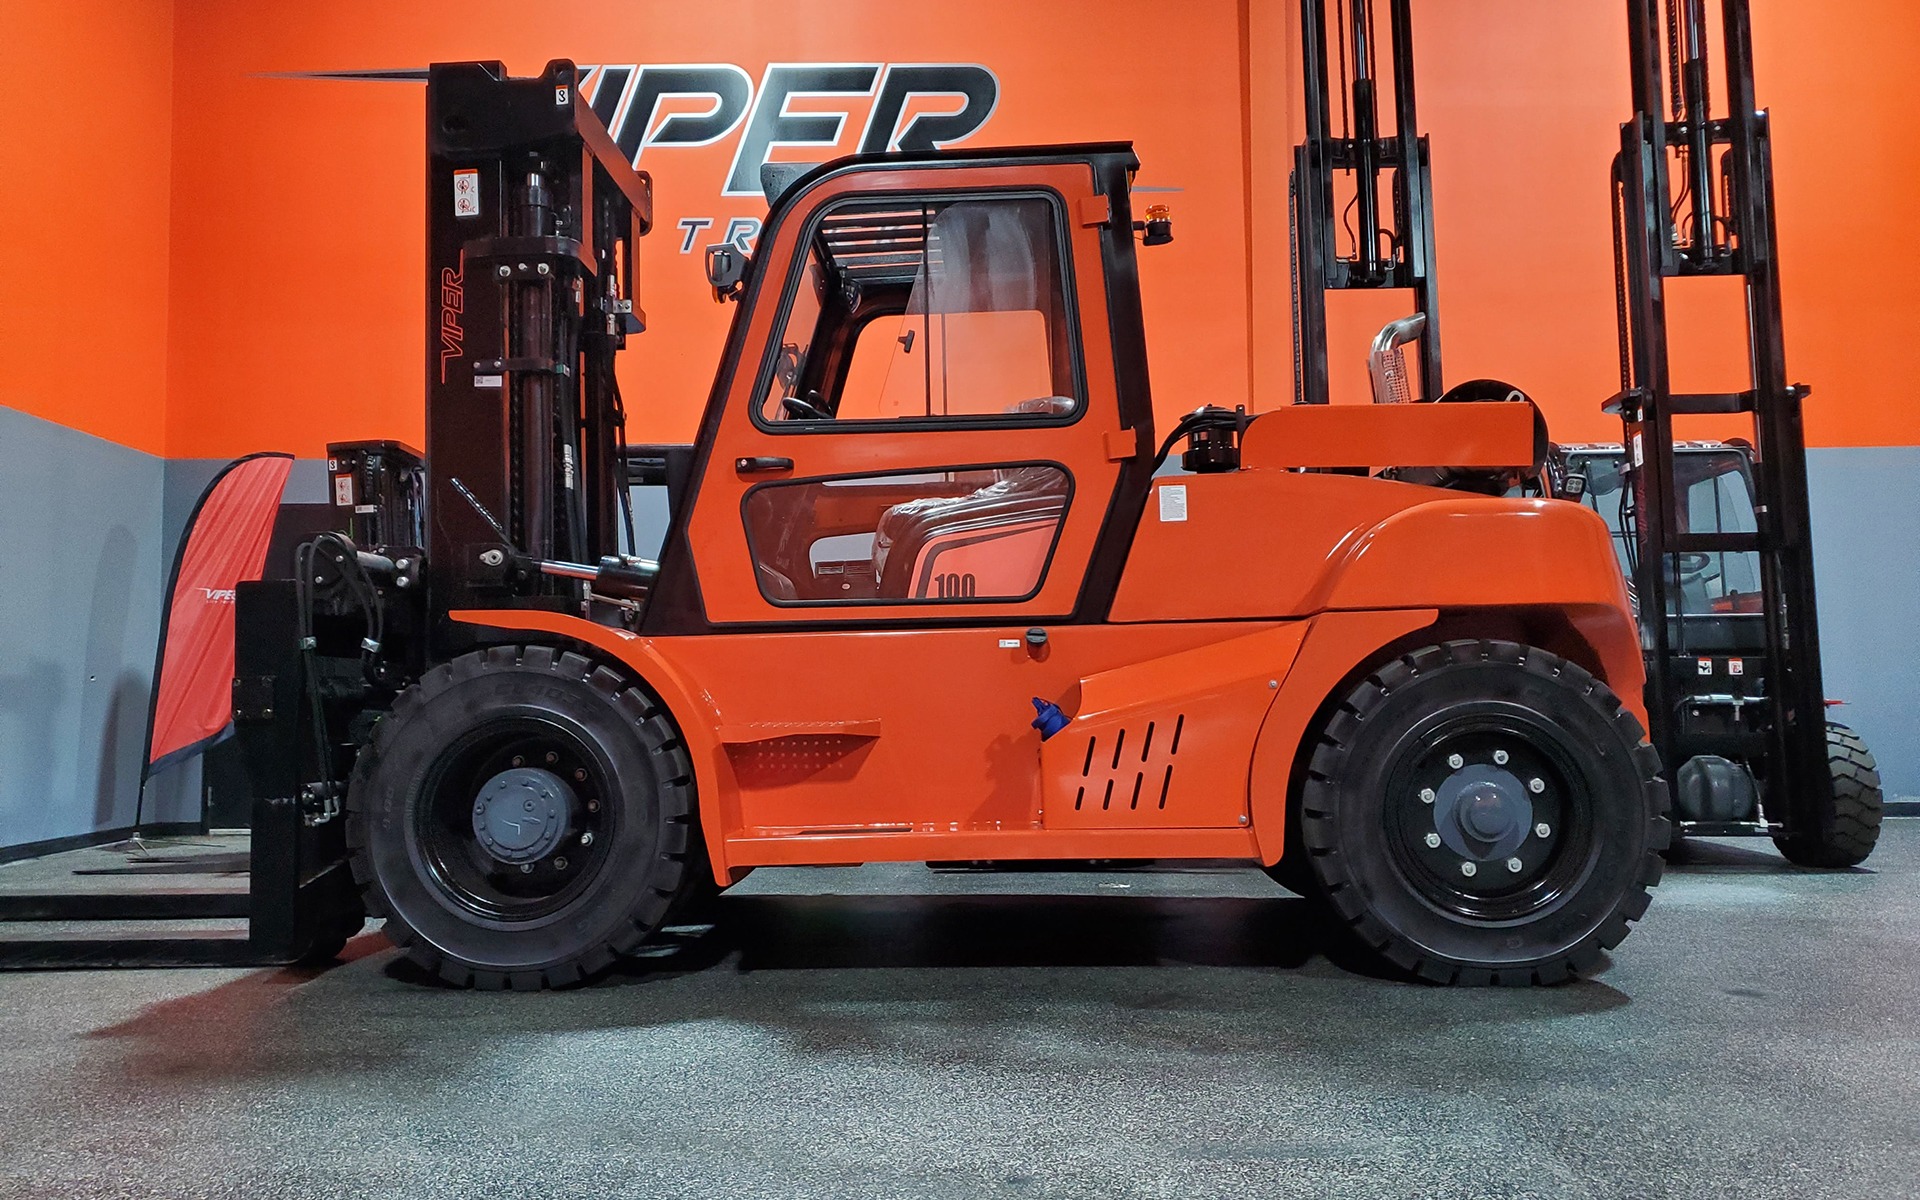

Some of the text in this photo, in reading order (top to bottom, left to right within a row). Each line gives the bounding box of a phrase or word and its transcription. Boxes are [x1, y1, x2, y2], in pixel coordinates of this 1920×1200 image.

[577, 63, 1000, 197] PER
[441, 255, 464, 380] VIPER
[934, 573, 976, 598] 100
